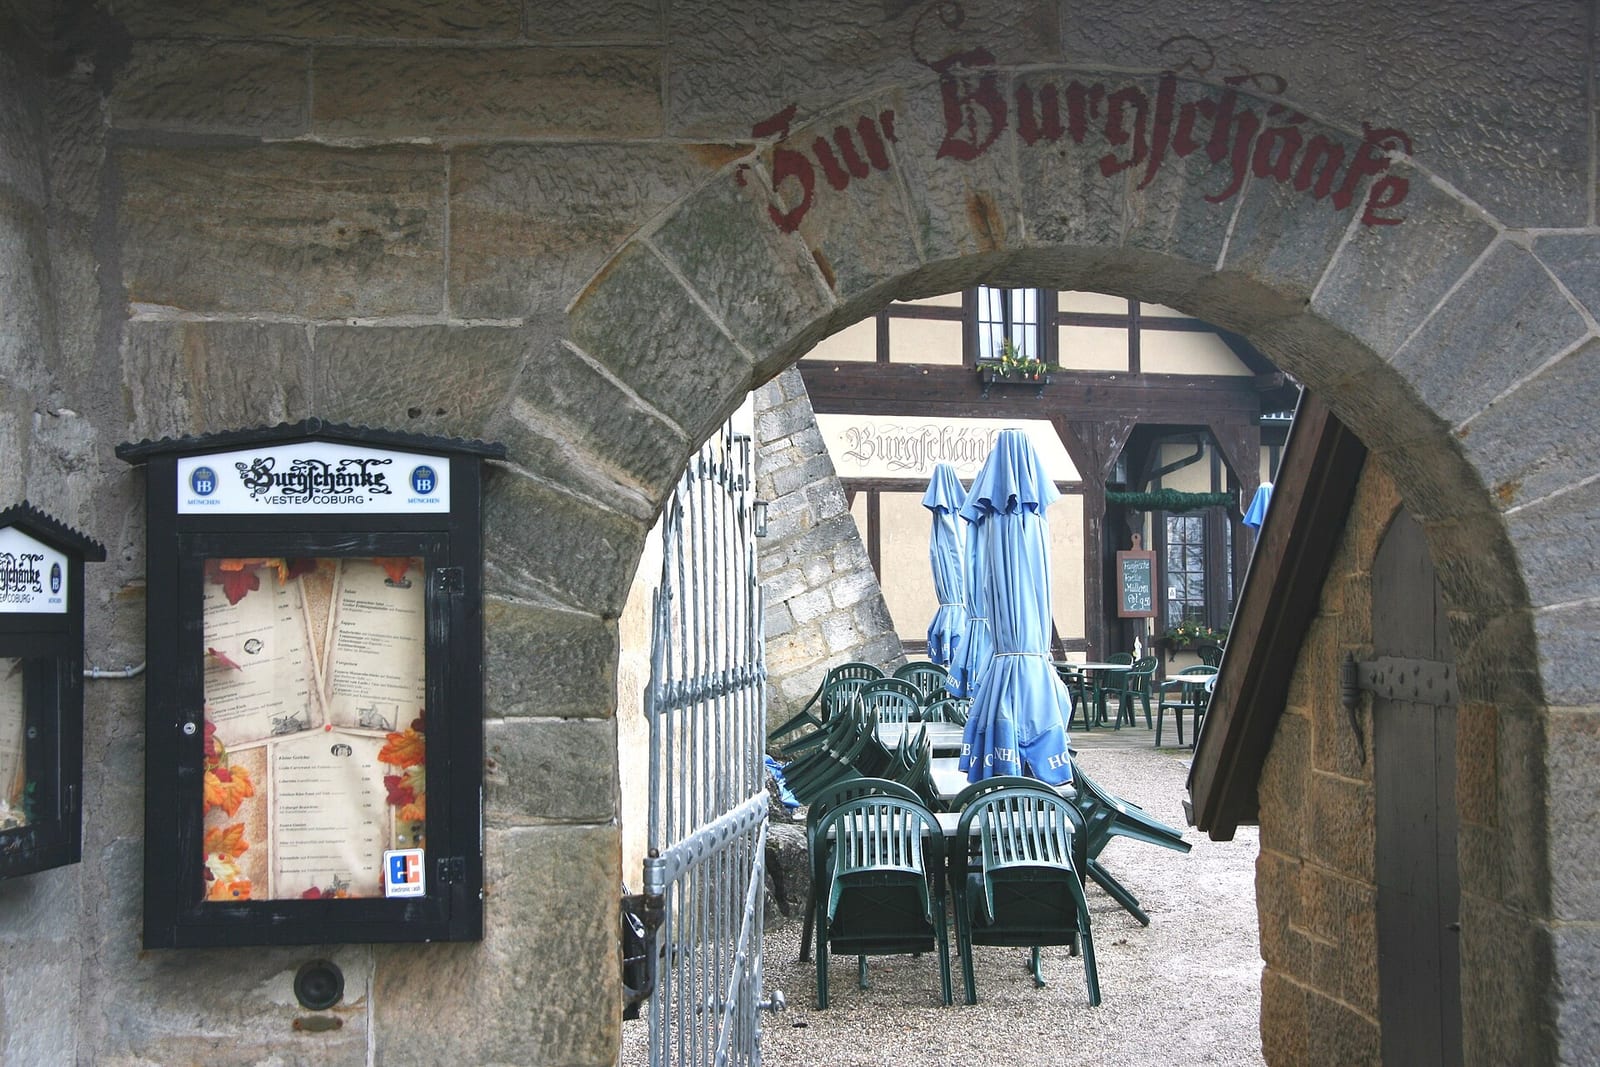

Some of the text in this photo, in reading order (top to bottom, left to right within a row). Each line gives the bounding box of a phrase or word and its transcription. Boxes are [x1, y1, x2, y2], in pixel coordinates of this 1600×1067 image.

[197, 481, 212, 492] HB
[417, 480, 432, 491] HB
[312, 496, 364, 505] COBURG
